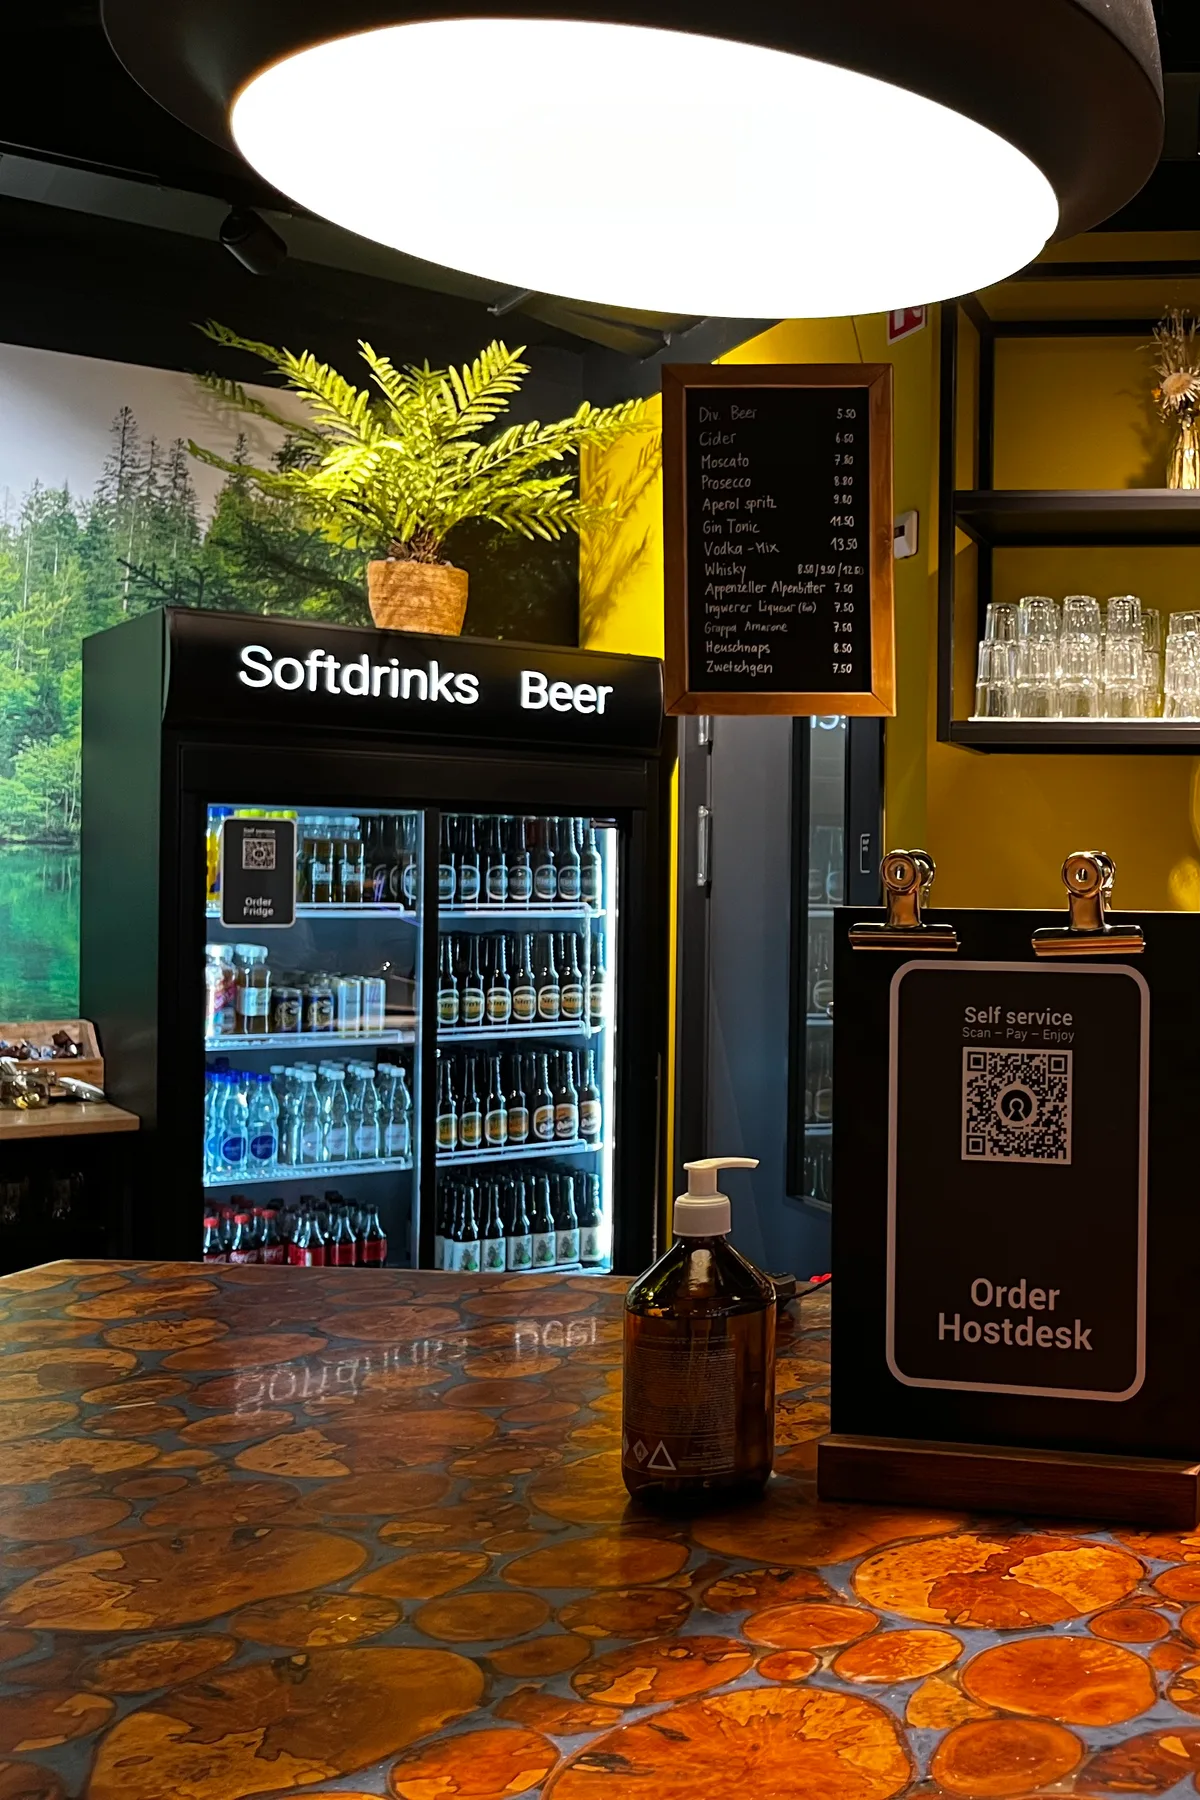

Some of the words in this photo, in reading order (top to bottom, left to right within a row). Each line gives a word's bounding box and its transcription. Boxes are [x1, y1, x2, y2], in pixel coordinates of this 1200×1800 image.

[730, 404, 758, 420] Beer
[836, 407, 856, 419] 5.50
[699, 431, 736, 446] Cider
[701, 453, 749, 469] Moscato
[701, 474, 751, 490] Prosecco
[702, 497, 739, 516] Aperol
[702, 520, 722, 534] Gin
[726, 518, 760, 534] Tonic
[829, 515, 855, 527] 11.50
[703, 541, 743, 556] Vodka
[829, 537, 858, 551] 13.50
[704, 562, 746, 585] Whisky
[704, 580, 767, 600] Appenzeller
[771, 580, 826, 597] Alpenbitter
[834, 582, 853, 594] 7.50
[705, 603, 752, 619] Ingwerer
[758, 600, 796, 616] Liqueur
[834, 602, 855, 613] 7.50
[704, 622, 737, 639] Grappa
[744, 621, 789, 633] Amarone
[833, 621, 853, 633] 7.50
[705, 640, 771, 659] Heuschnaps
[833, 643, 853, 654] 8.50
[706, 660, 773, 677] Zwetschgen
[832, 663, 853, 674] 7.50
[238, 644, 480, 705] Softdrinks
[520, 670, 614, 715] Beer
[245, 896, 273, 906] Order
[243, 906, 274, 918] Fridge
[964, 1006, 1001, 1024] Self
[1006, 1007, 1073, 1026] service
[962, 1026, 991, 1038] Scan
[1006, 1028, 1028, 1042] Pay
[1043, 1029, 1075, 1043] Enjoy
[970, 1277, 1061, 1311] Order
[938, 1312, 1093, 1351] Hostdesk
